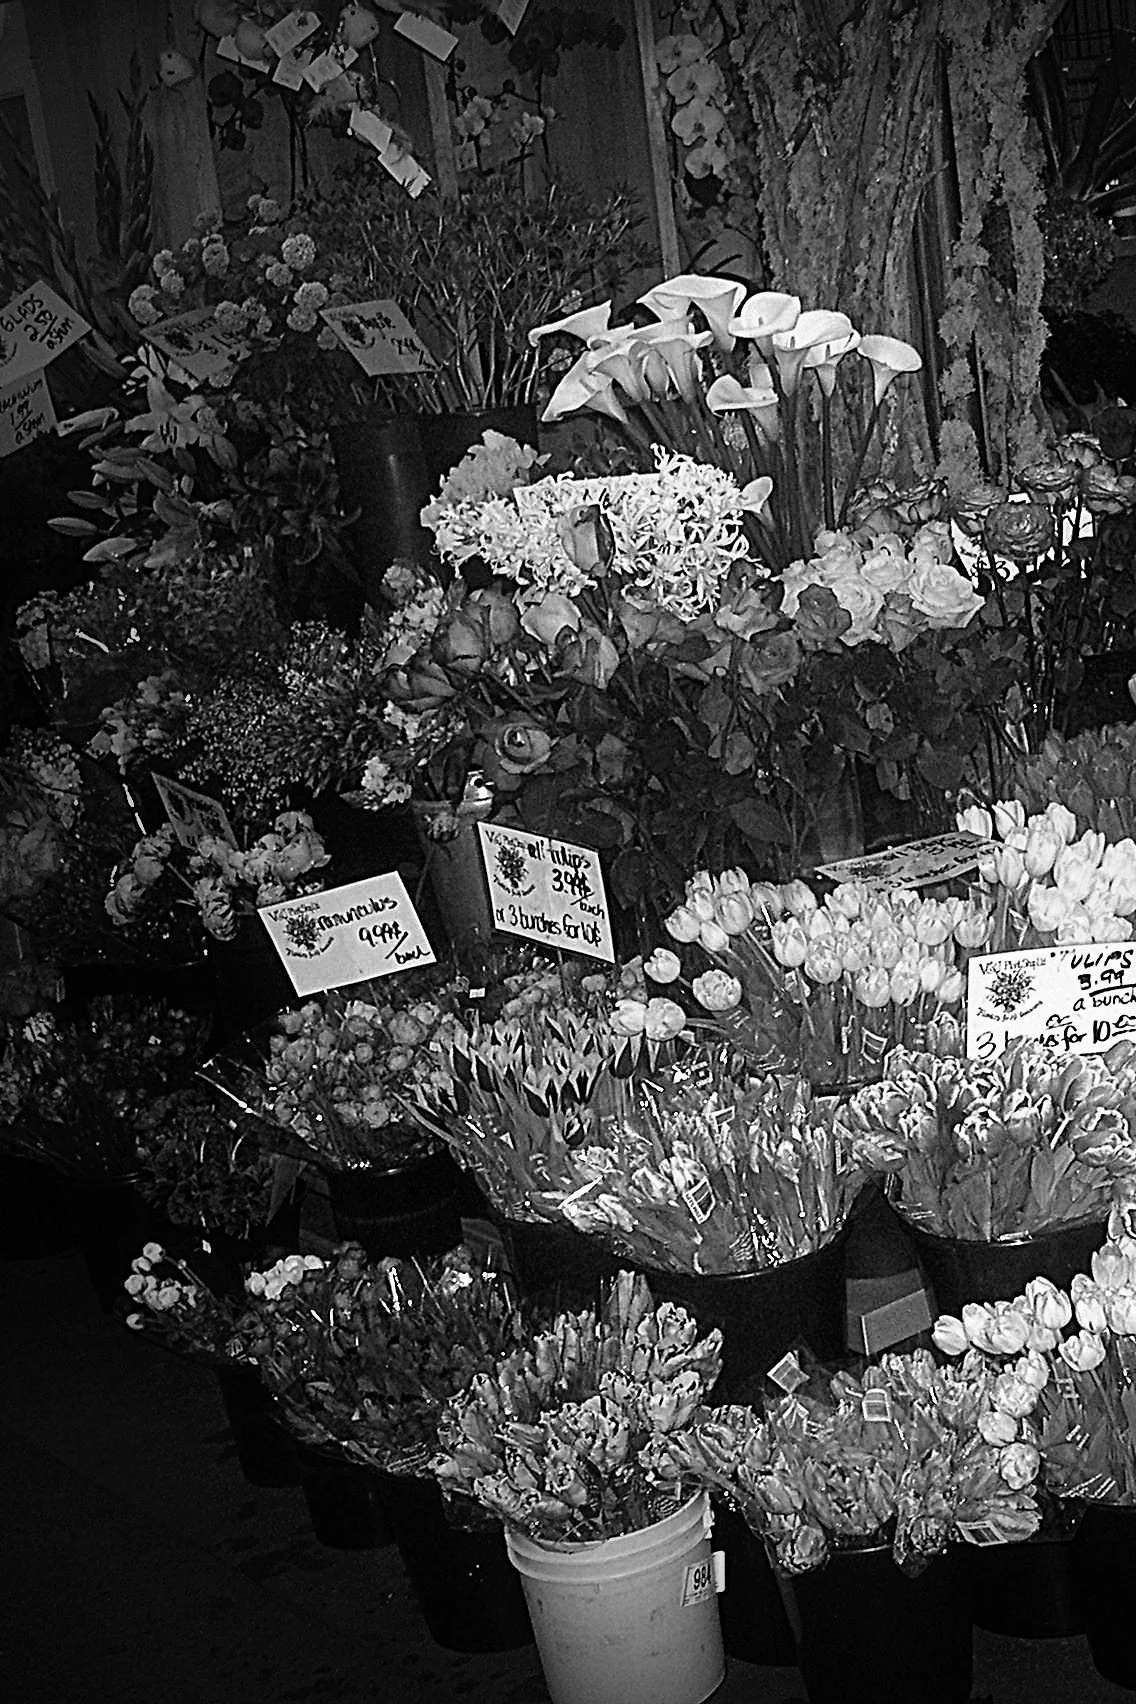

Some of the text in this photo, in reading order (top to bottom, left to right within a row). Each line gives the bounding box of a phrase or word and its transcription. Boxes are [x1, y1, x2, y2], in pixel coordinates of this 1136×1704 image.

[0, 293, 44, 332] GLADS
[508, 904, 519, 927] 3
[1073, 997, 1087, 1012] a
[976, 1031, 998, 1061] 3
[1061, 1025, 1088, 1052] for
